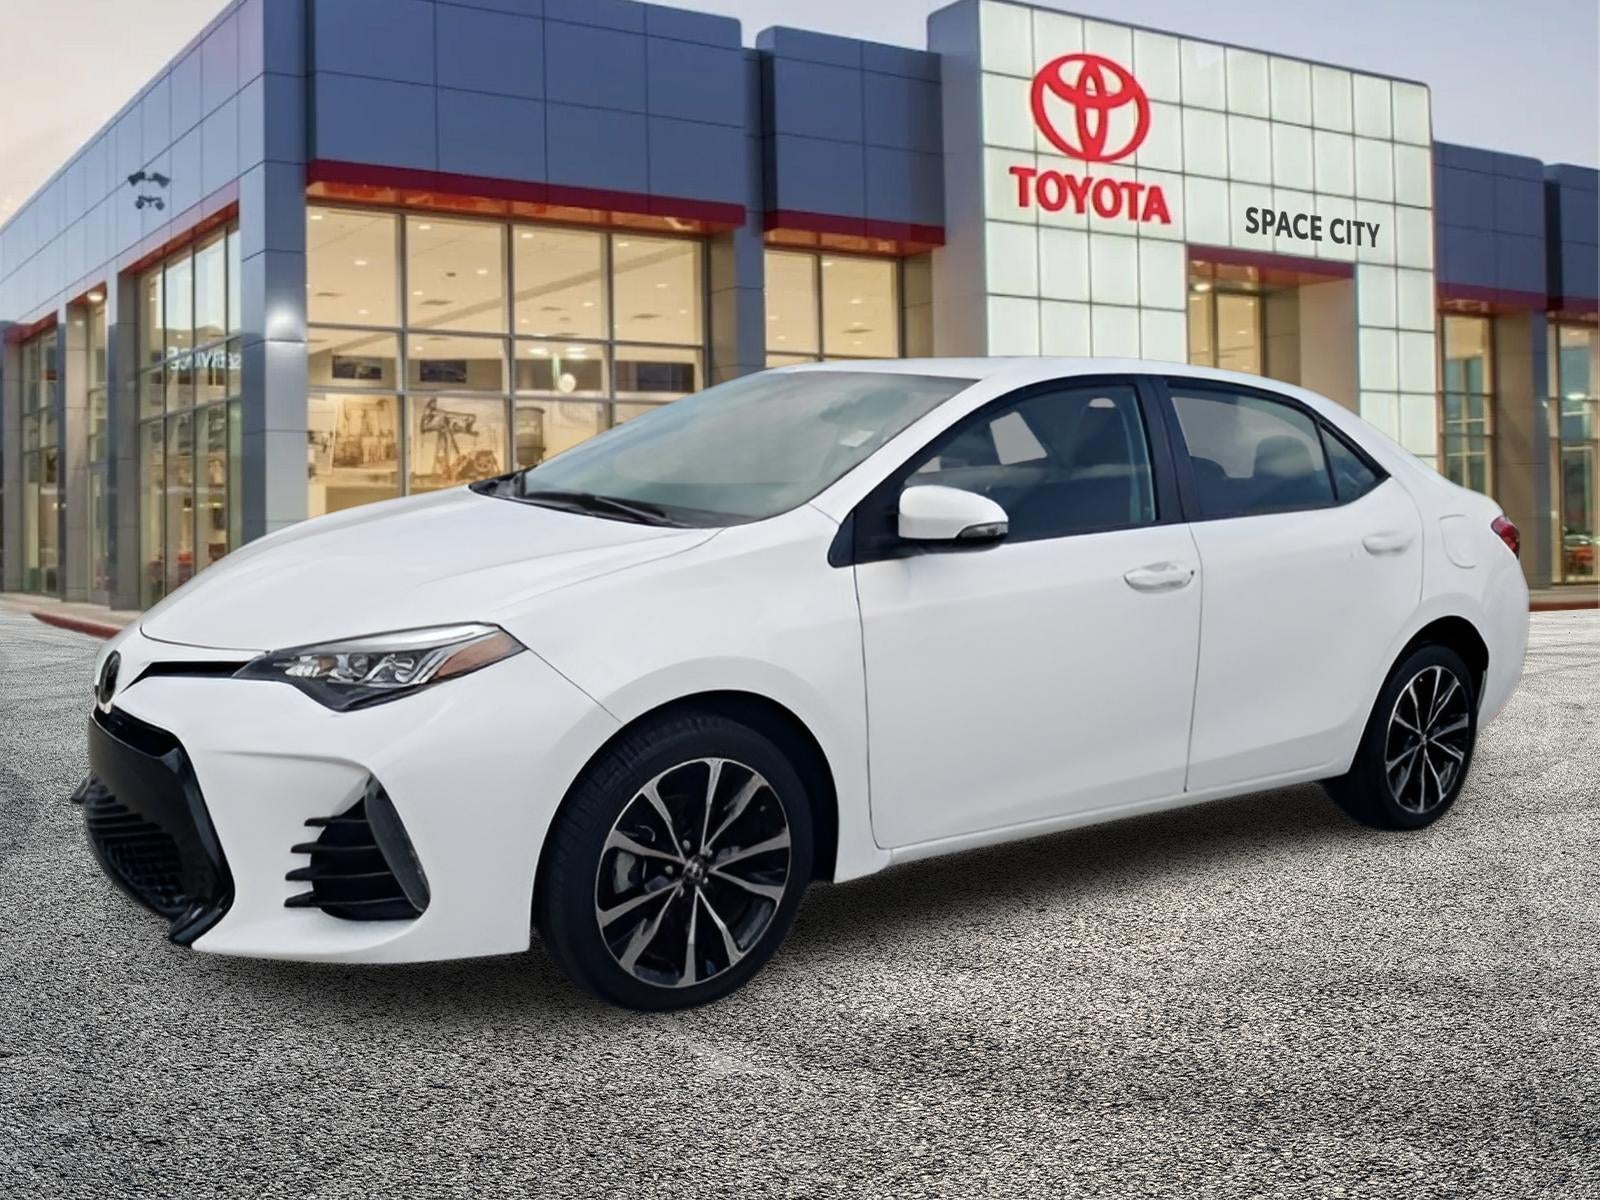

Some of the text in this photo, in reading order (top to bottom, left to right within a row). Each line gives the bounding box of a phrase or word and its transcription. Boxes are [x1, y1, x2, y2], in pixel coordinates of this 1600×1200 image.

[1009, 166, 1171, 224] TOYOTA
[1244, 207, 1381, 248] SPACE CITY
